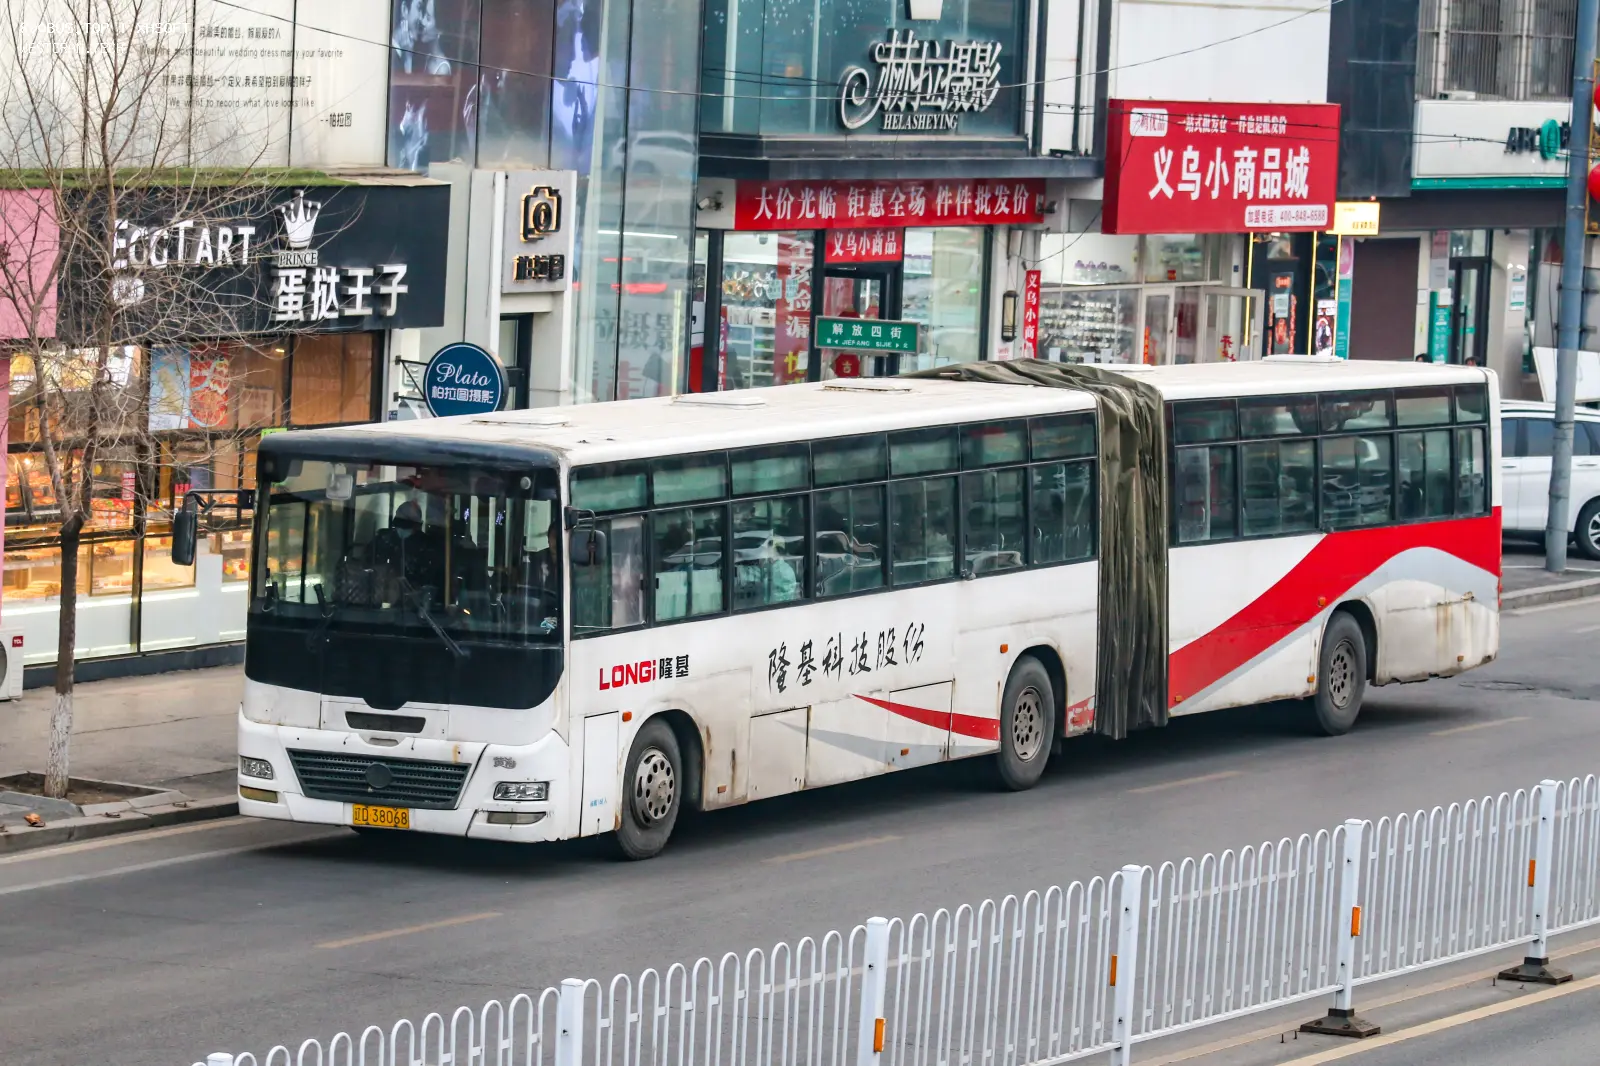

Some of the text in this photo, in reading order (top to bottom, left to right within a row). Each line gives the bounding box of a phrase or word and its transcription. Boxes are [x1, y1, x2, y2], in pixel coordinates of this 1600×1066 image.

[229, 48, 257, 60] wedding
[260, 48, 278, 58] dress
[302, 50, 315, 60] your
[317, 48, 344, 58] favorite
[217, 97, 239, 108] record
[244, 97, 260, 108] what
[301, 97, 315, 108] like
[883, 114, 958, 130] HELASHEYING
[1148, 146, 1311, 200] 义乌小商品城
[753, 183, 1029, 221] 大价光临 钜惠全场 件件批发价
[832, 231, 897, 257] 义乌小商品
[279, 251, 318, 266] PRINCE
[273, 264, 409, 321] 蛋挞王子
[832, 322, 902, 339] 解放四街
[841, 339, 870, 347] JIEFANG
[436, 362, 491, 386] Plato
[658, 654, 690, 679] 隆基
[768, 622, 925, 695] 隆基科技股份
